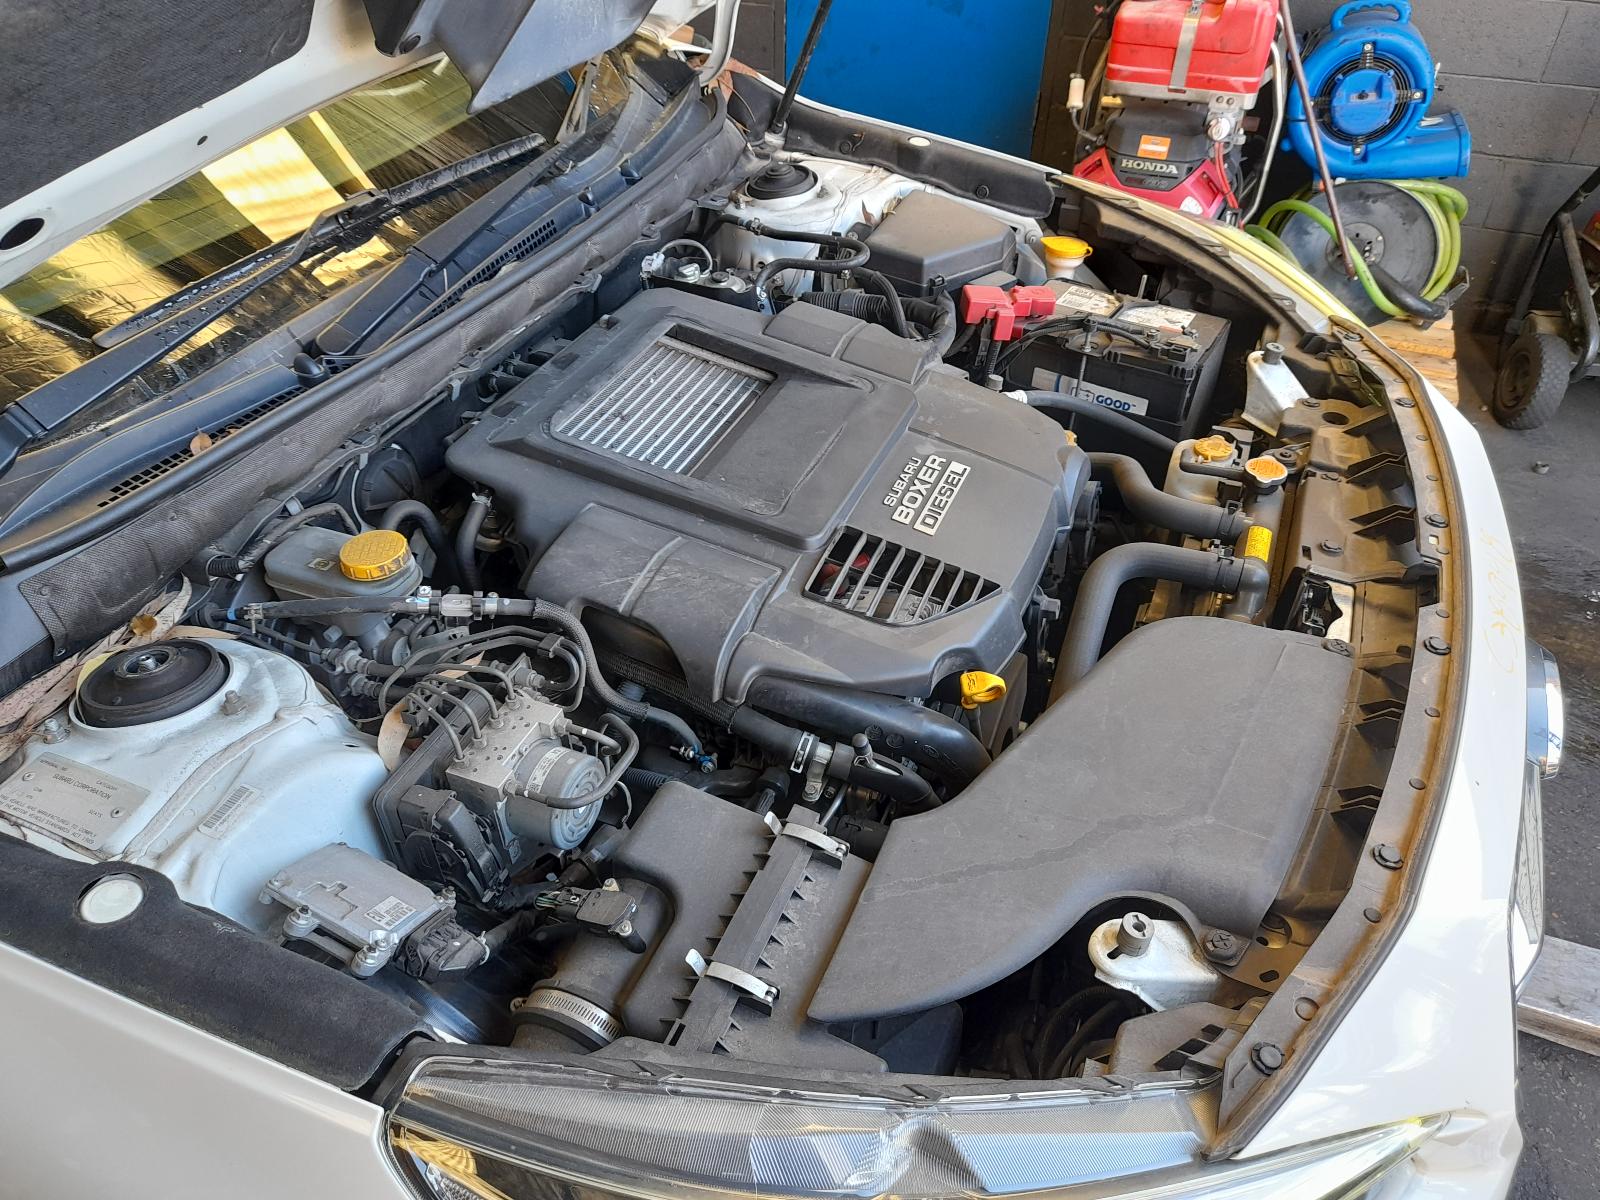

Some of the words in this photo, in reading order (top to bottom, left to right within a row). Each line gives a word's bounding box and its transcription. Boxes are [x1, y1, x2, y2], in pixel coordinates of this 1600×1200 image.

[1121, 159, 1178, 174] HONDA
[883, 457, 921, 506] SUBARU
[891, 455, 946, 525] BOXER
[919, 467, 968, 530] DIESEL
[53, 773, 74, 786] SUBARU
[73, 781, 112, 800] CORPORATION
